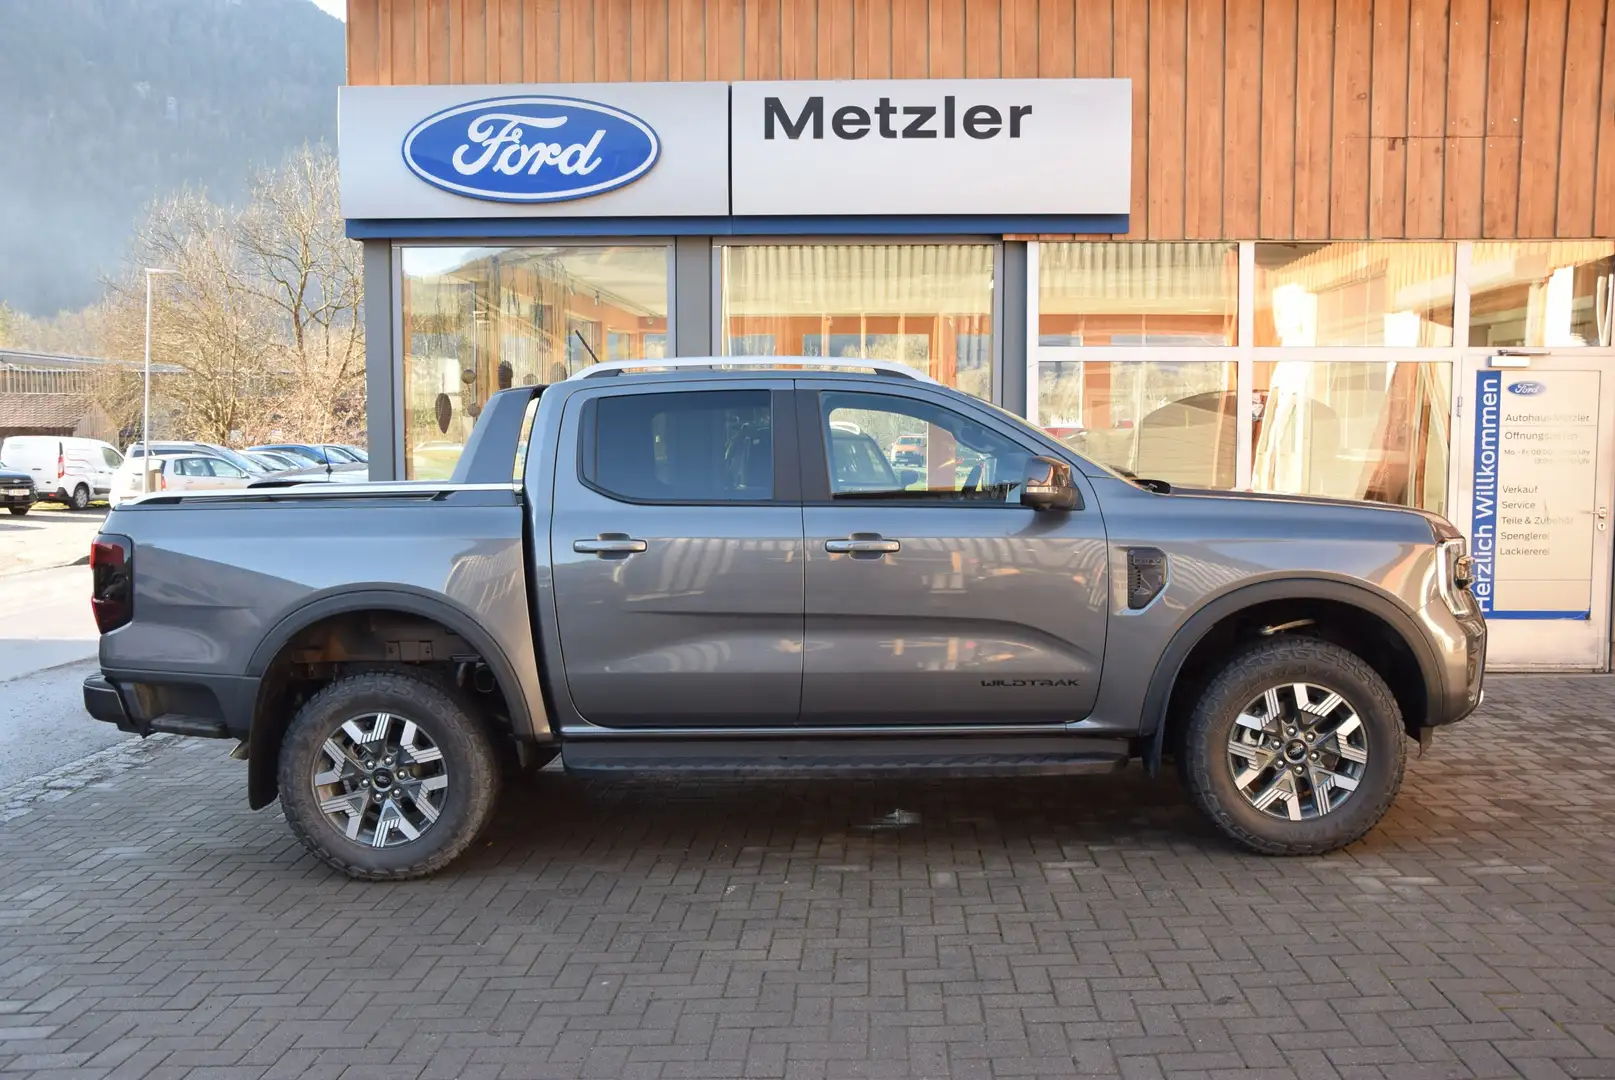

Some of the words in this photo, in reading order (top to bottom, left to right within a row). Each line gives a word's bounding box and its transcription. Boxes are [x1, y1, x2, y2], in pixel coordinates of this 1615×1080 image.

[764, 95, 1032, 140] Metzler
[452, 113, 606, 176] Ford
[1475, 379, 1498, 519] Willkommen
[1502, 485, 1538, 494] Verkauf
[1501, 501, 1536, 509] Service
[1501, 516, 1523, 525] Teile
[1524, 517, 1531, 525] &
[1474, 524, 1494, 612] Herzlich
[981, 679, 1079, 687] WILDTRAK
